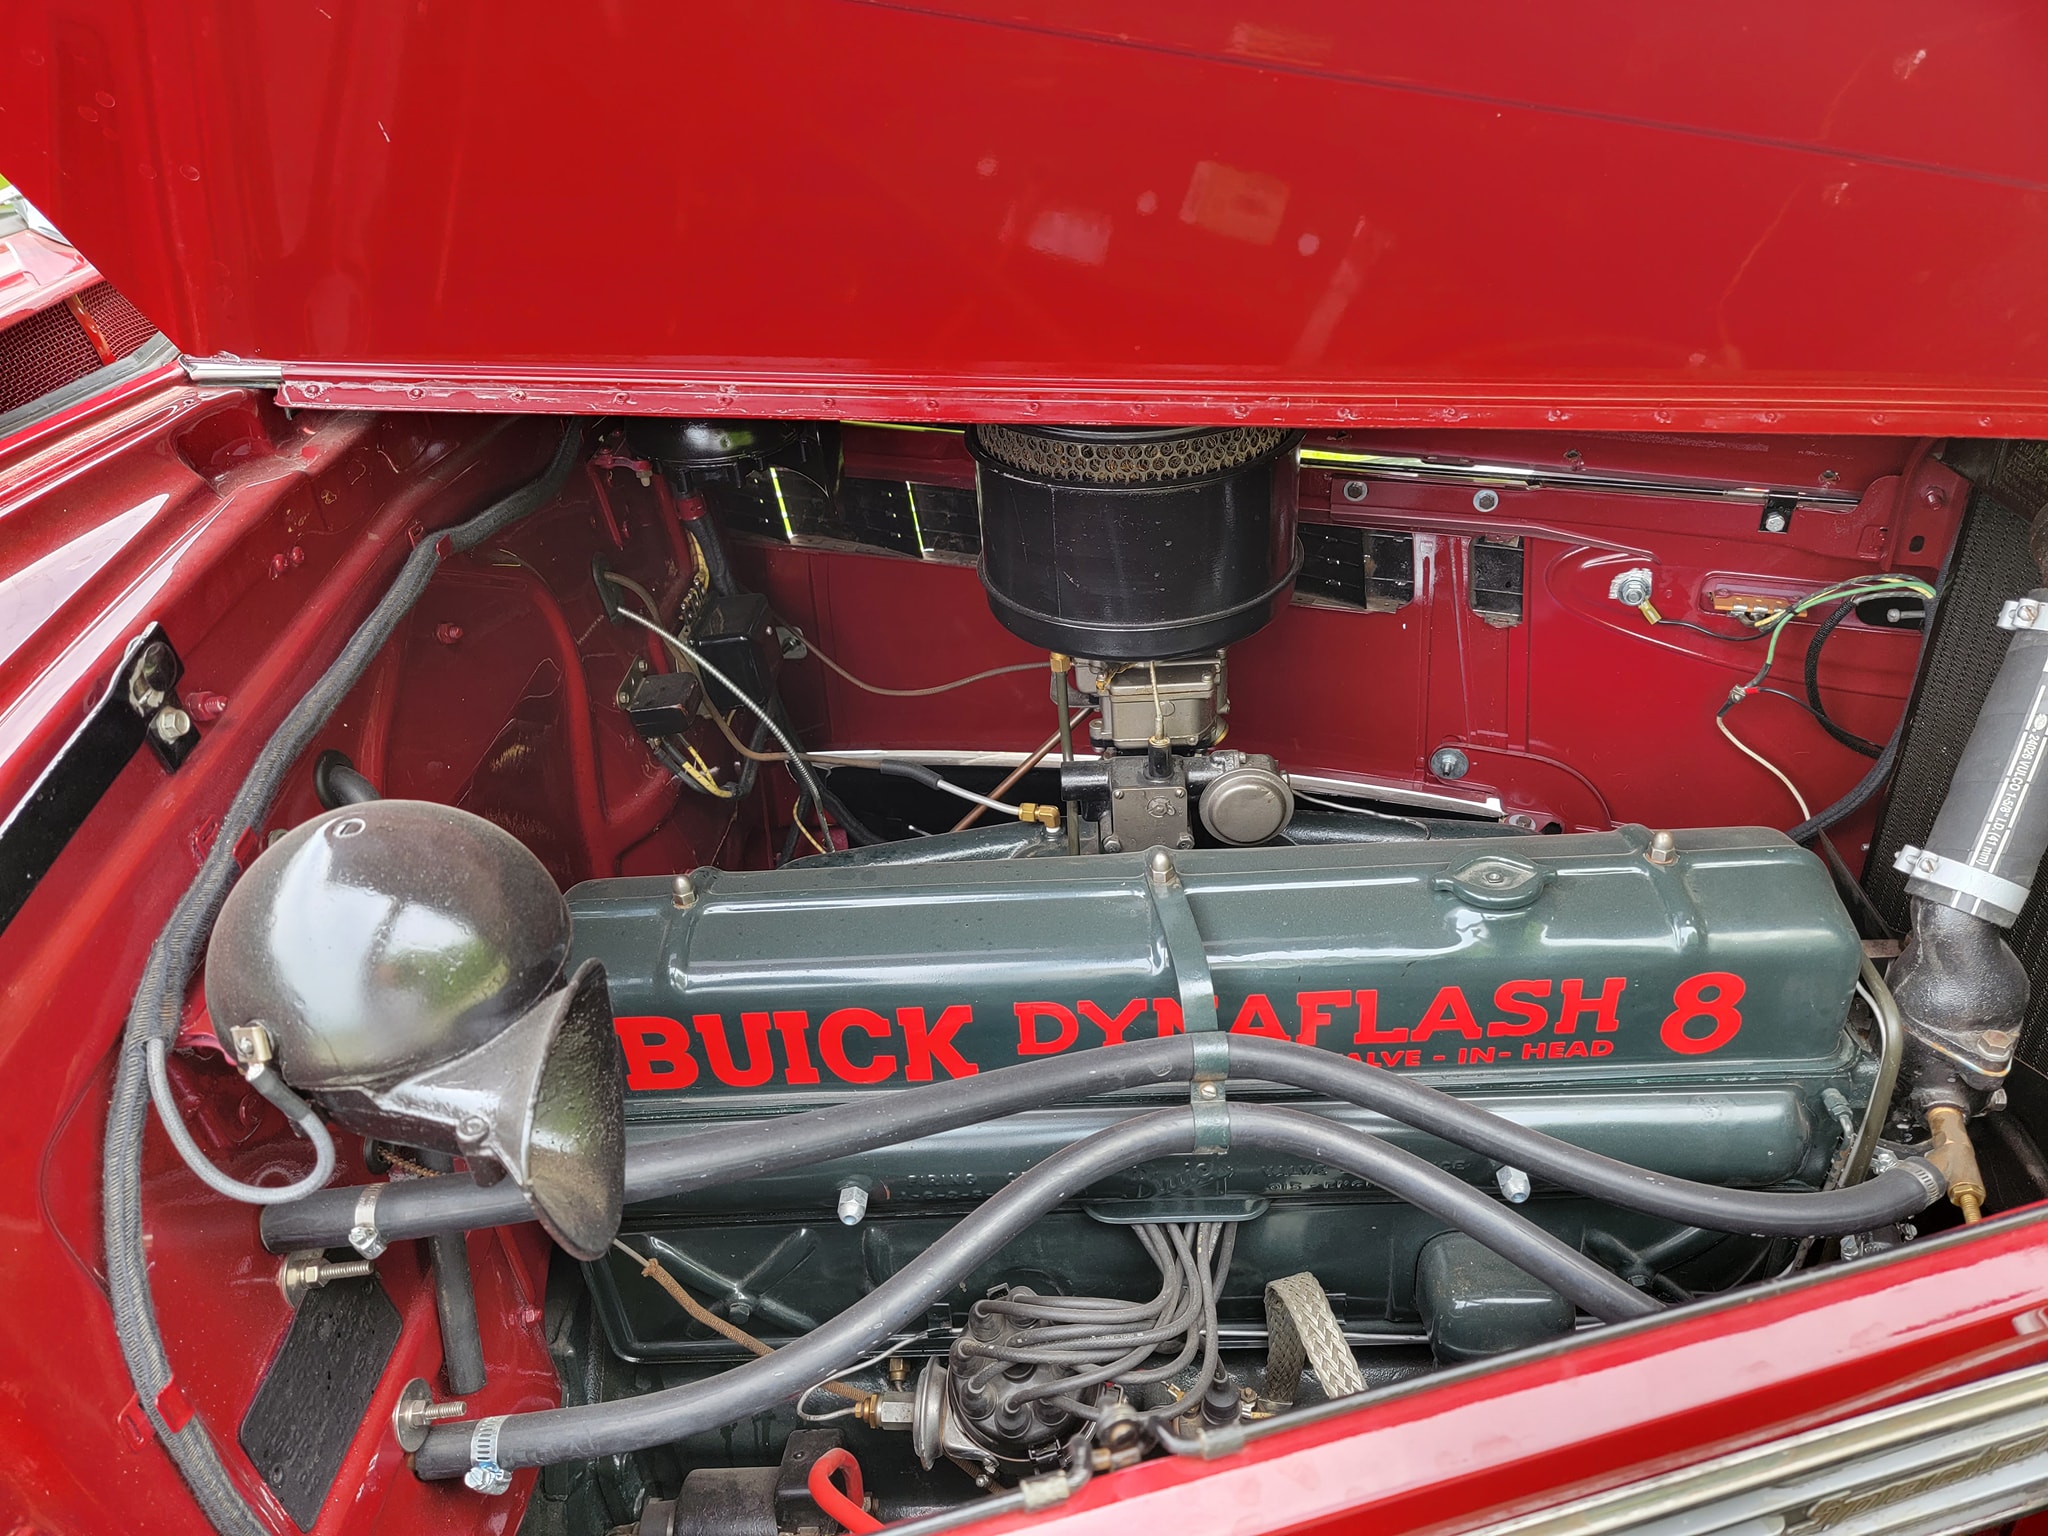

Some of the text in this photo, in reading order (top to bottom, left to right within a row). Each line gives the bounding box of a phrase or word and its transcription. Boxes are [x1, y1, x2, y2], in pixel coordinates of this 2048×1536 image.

[2021, 732, 2041, 760] 24026
[2009, 759, 2032, 791] VULCO
[1993, 817, 2008, 831] I.D.
[1987, 831, 2002, 847] (41
[1975, 844, 1995, 867] mm)
[613, 1003, 979, 1087] BUICK
[1659, 971, 1745, 1055] 8
[1346, 1049, 1421, 1069] LVE
[1521, 1041, 1614, 1060] HEAD
[907, 1173, 978, 1187] FIRING
